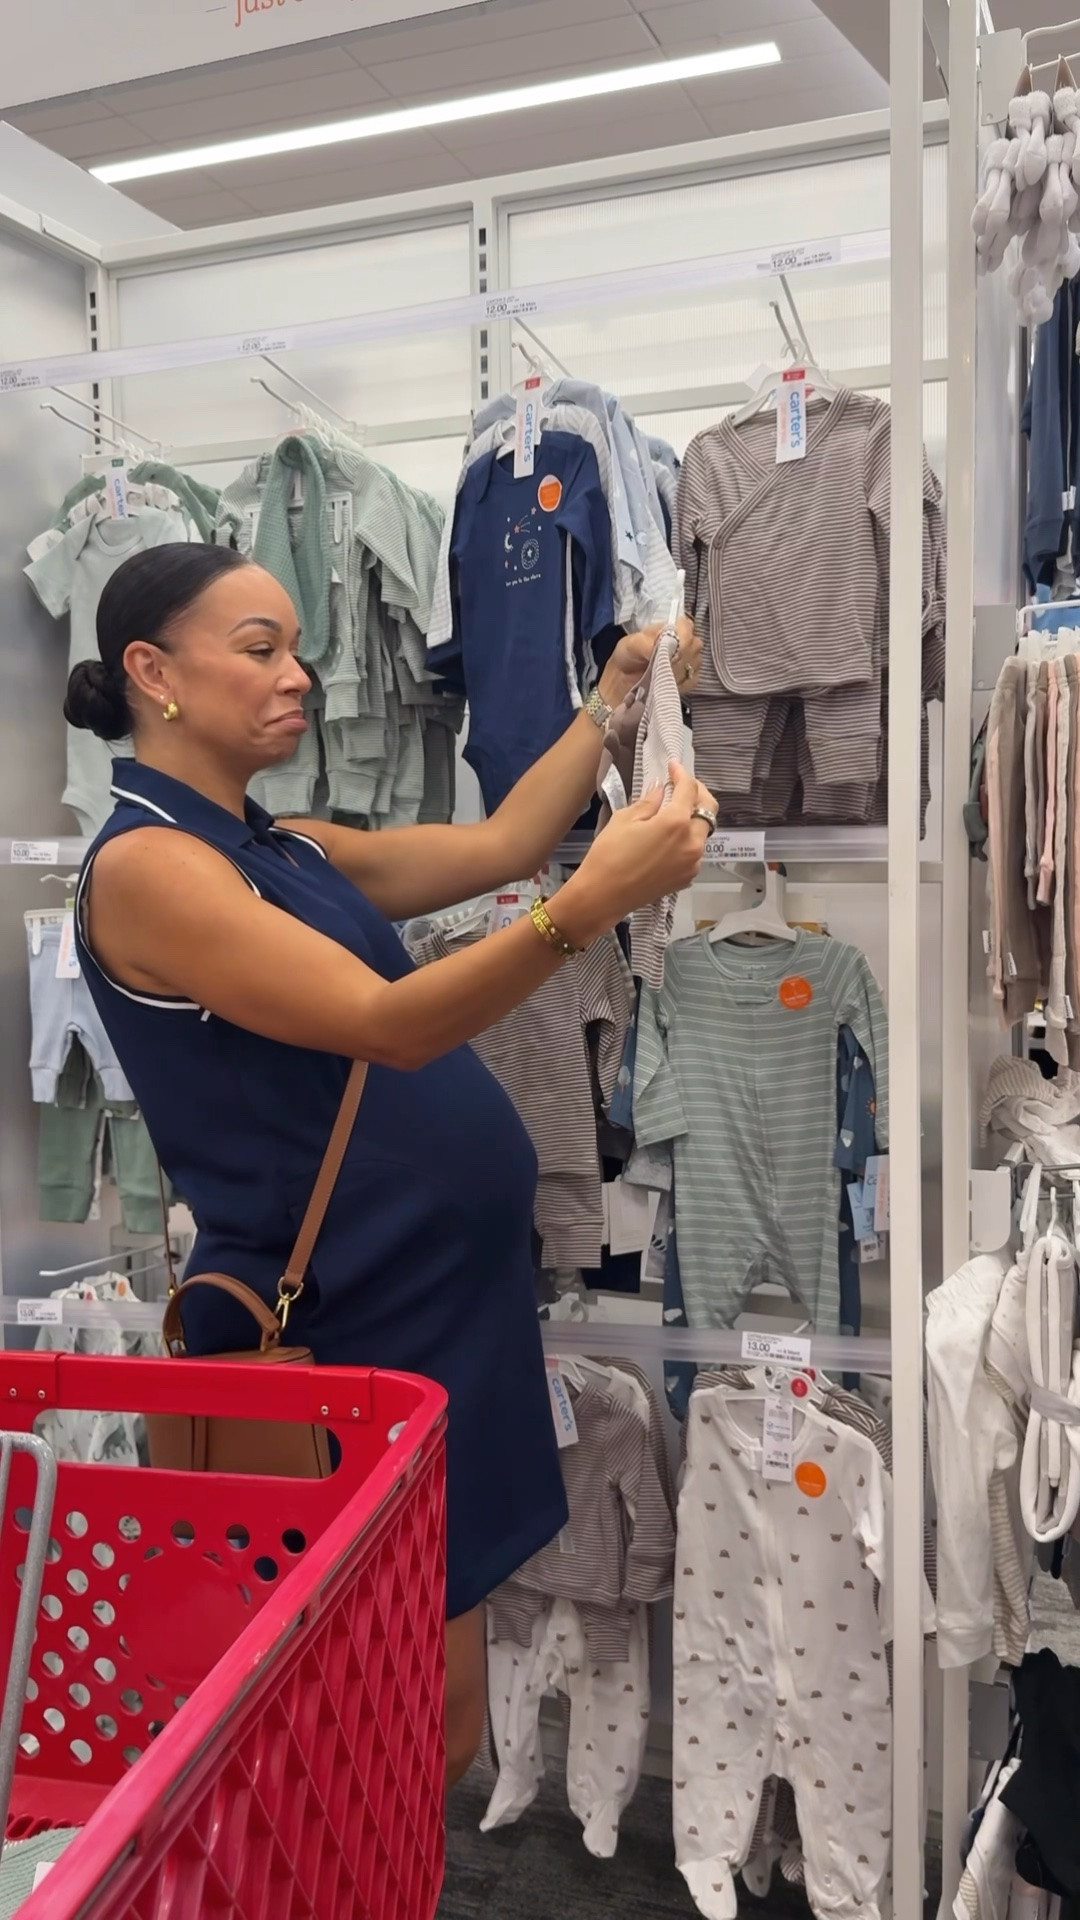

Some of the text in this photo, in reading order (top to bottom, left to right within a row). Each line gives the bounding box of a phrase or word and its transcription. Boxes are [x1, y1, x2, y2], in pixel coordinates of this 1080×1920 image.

[772, 256, 797, 268] 12.00
[486, 304, 507, 314] 12.00
[790, 391, 804, 448] carter's
[523, 403, 534, 463] carter's
[113, 478, 126, 517] carter
[705, 844, 724, 853] 0.00
[747, 1341, 771, 1352] 13.00
[551, 1378, 573, 1432] carter's
